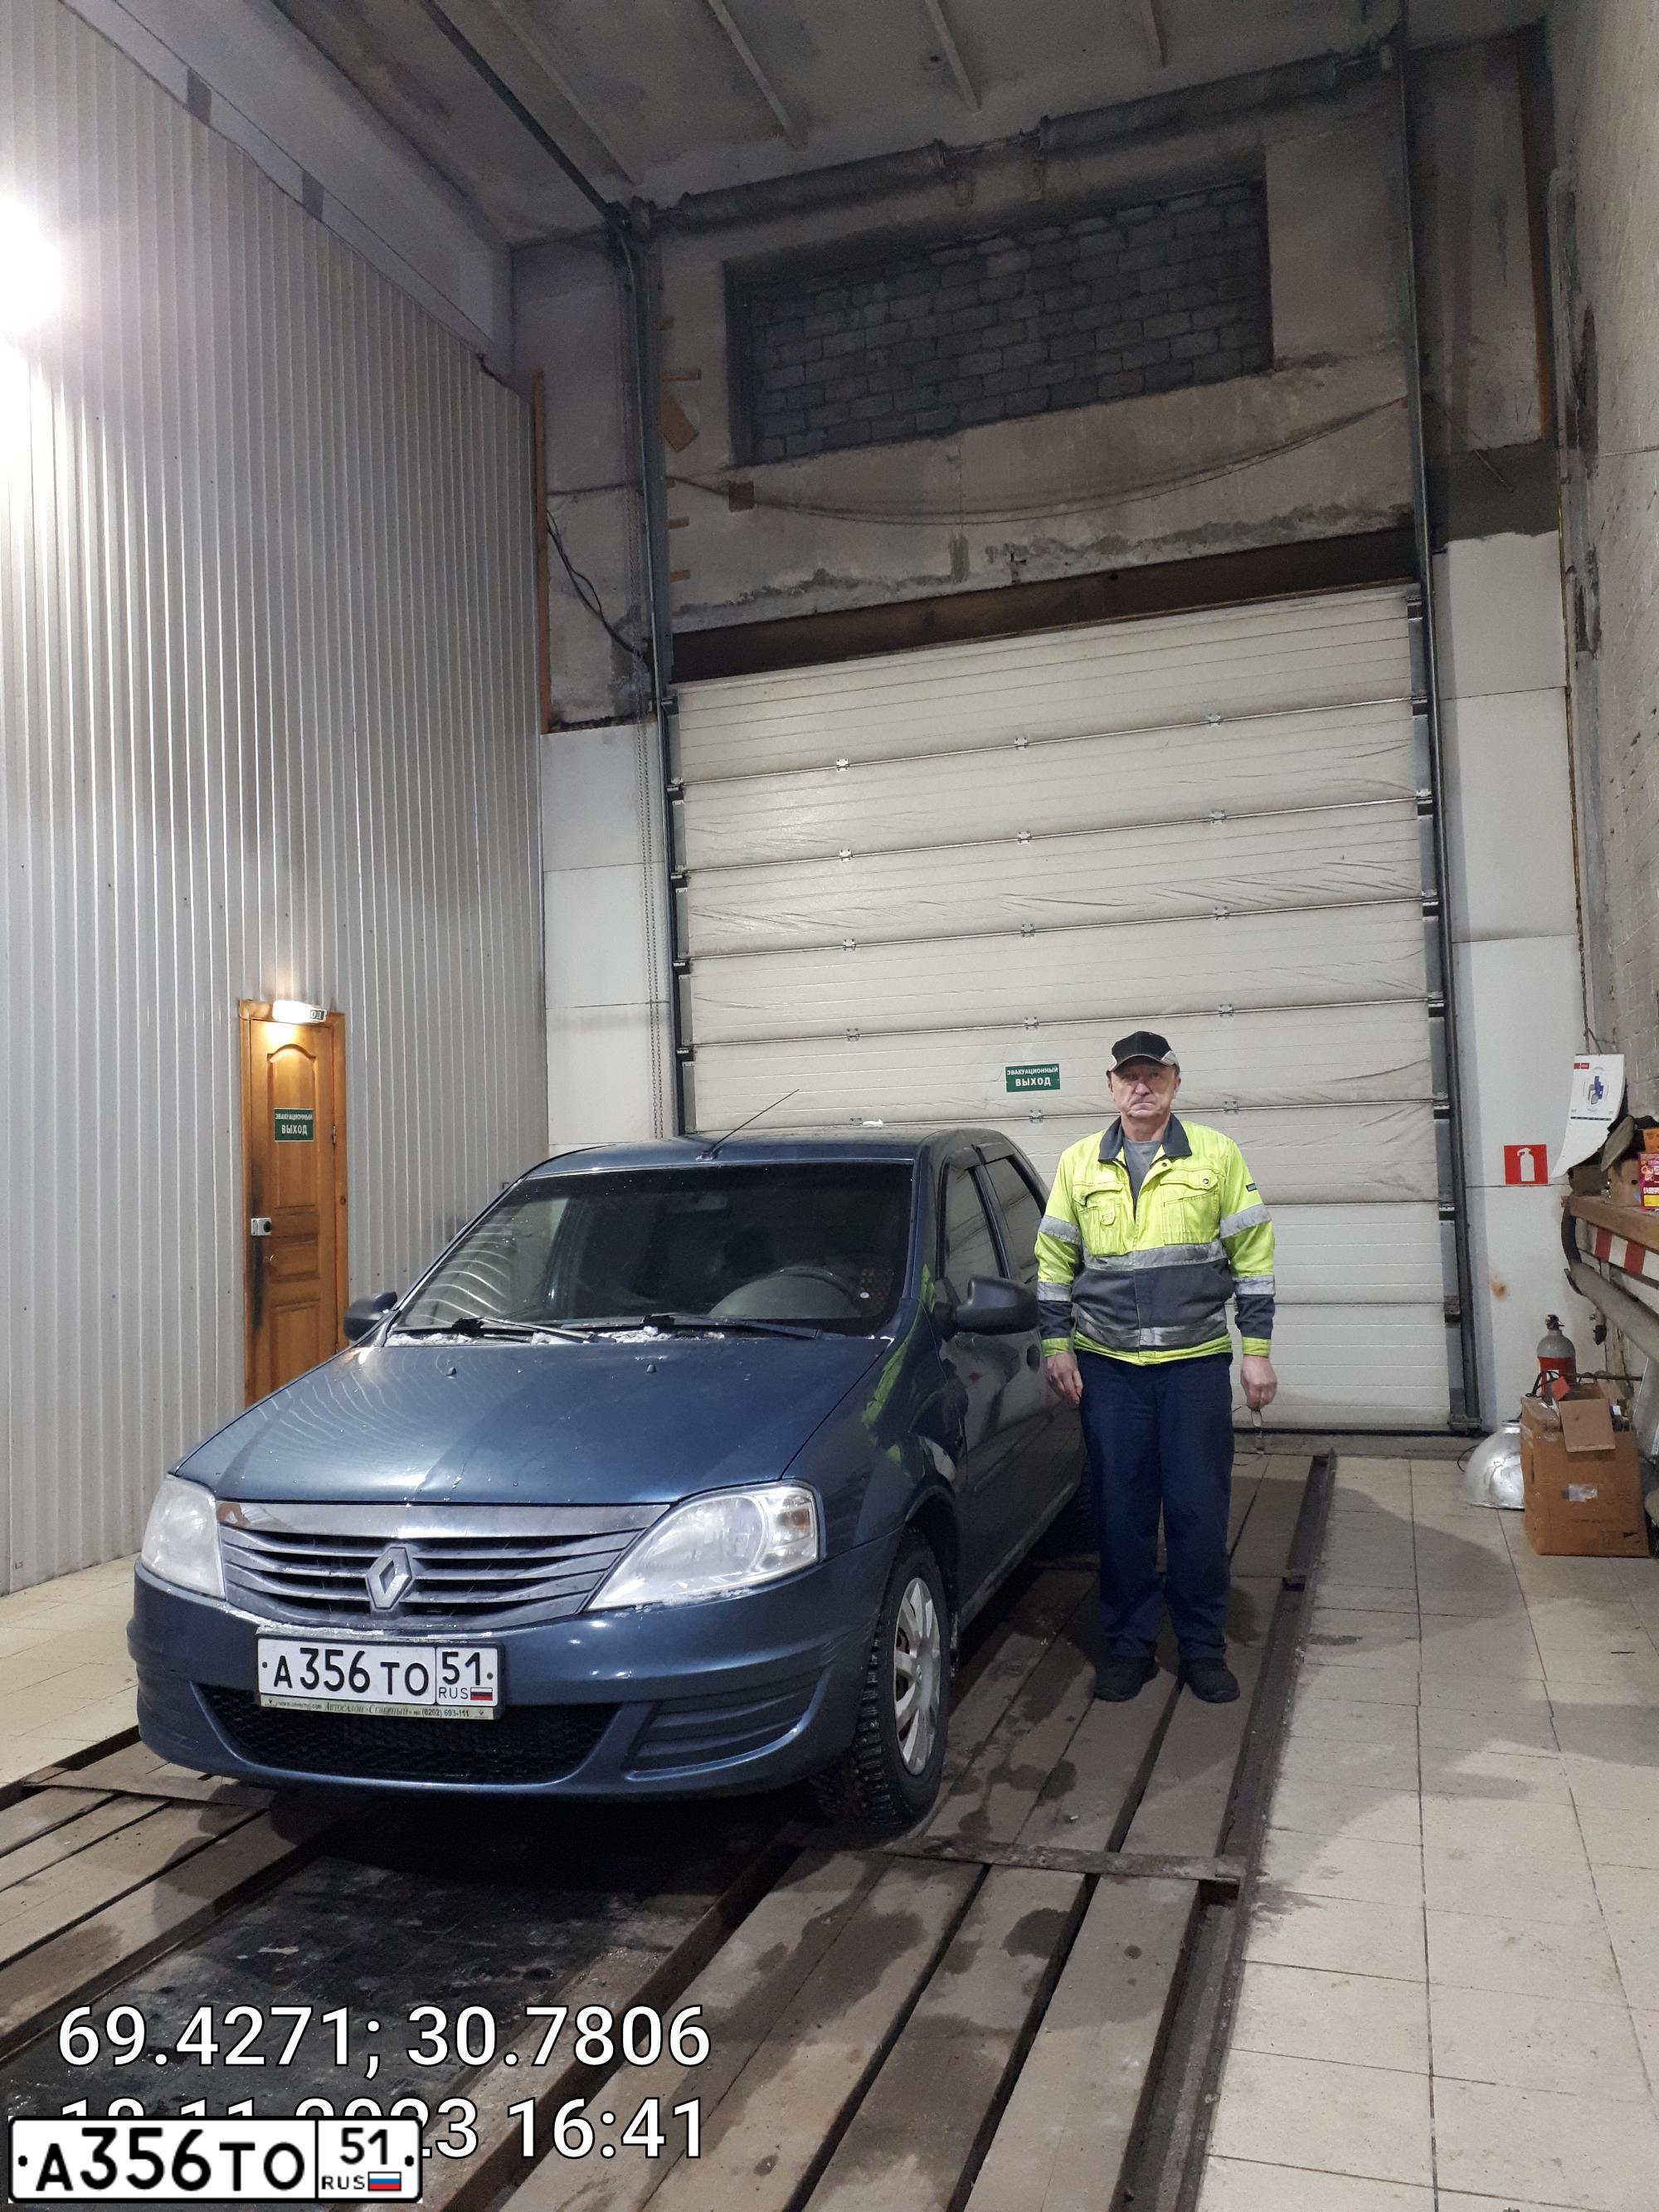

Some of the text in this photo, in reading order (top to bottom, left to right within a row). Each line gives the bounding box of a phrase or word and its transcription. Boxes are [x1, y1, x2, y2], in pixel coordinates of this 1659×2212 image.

[1006, 1066, 1058, 1075] ЭВАКУАЦИОННЫЙ
[1015, 1077, 1051, 1086] ВЫХОД
[281, 1124, 308, 1135] ВЫХОД
[442, 1651, 481, 1686] 51
[438, 1687, 469, 1699] RUS
